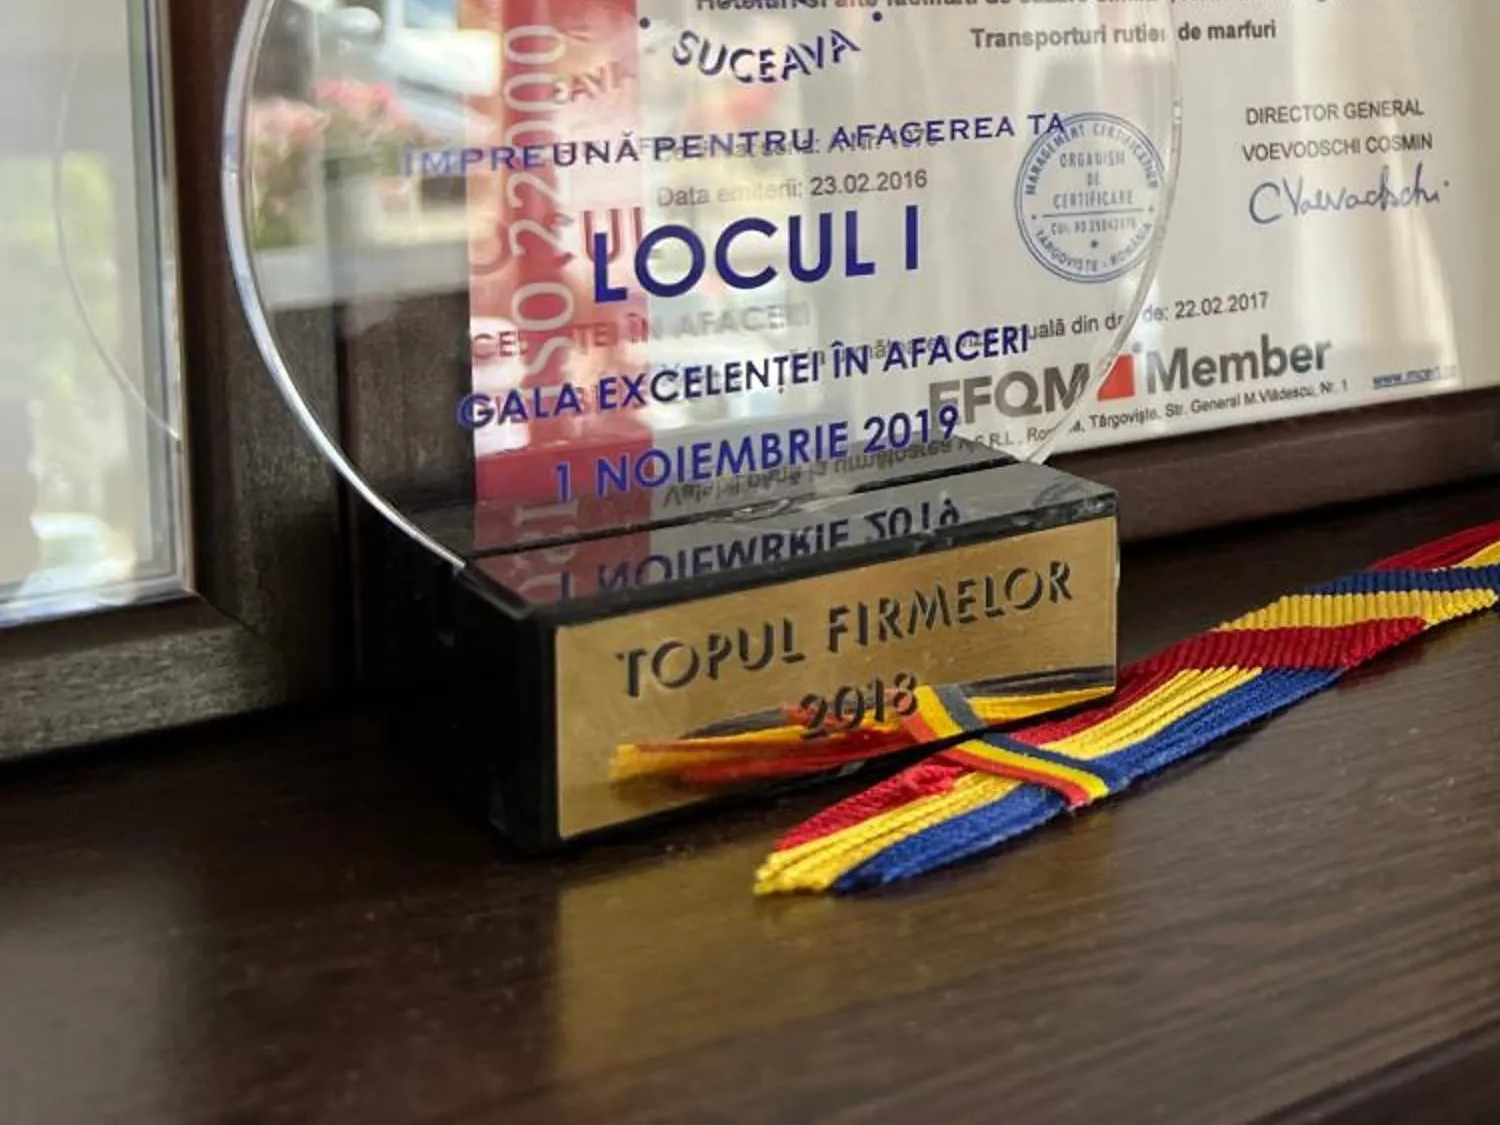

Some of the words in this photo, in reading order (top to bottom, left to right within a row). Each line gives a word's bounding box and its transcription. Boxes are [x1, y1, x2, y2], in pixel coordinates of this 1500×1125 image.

[671, 26, 862, 85] SUCEAVA
[970, 24, 1107, 51] Transporturi
[1177, 21, 1202, 41] de
[1207, 18, 1278, 40] marfuri
[653, 127, 815, 162] PENTRU
[830, 115, 1016, 153] AFACEREA
[1027, 112, 1066, 136] TA
[1245, 101, 1339, 126] DIRECTOR
[1343, 98, 1424, 120] GENERAL
[1365, 133, 1432, 155] COSMIN
[657, 185, 710, 207] Data
[809, 169, 929, 197] 23.02.2016
[593, 210, 876, 304] LOCUL
[904, 204, 919, 270] I
[1071, 314, 1099, 335] din
[1174, 291, 1269, 320] 22.02.2017
[457, 383, 583, 431] GALA
[831, 340, 870, 378] ÎN
[882, 323, 1029, 372] AFACERI
[1145, 333, 1332, 395] Member
[1190, 391, 1242, 414] General
[594, 421, 849, 499] NOIEMBRIE
[862, 404, 960, 454] 2019
[615, 617, 807, 699] TOPUL
[827, 558, 1074, 654] FIRMELOR
[799, 671, 919, 738] 2018
